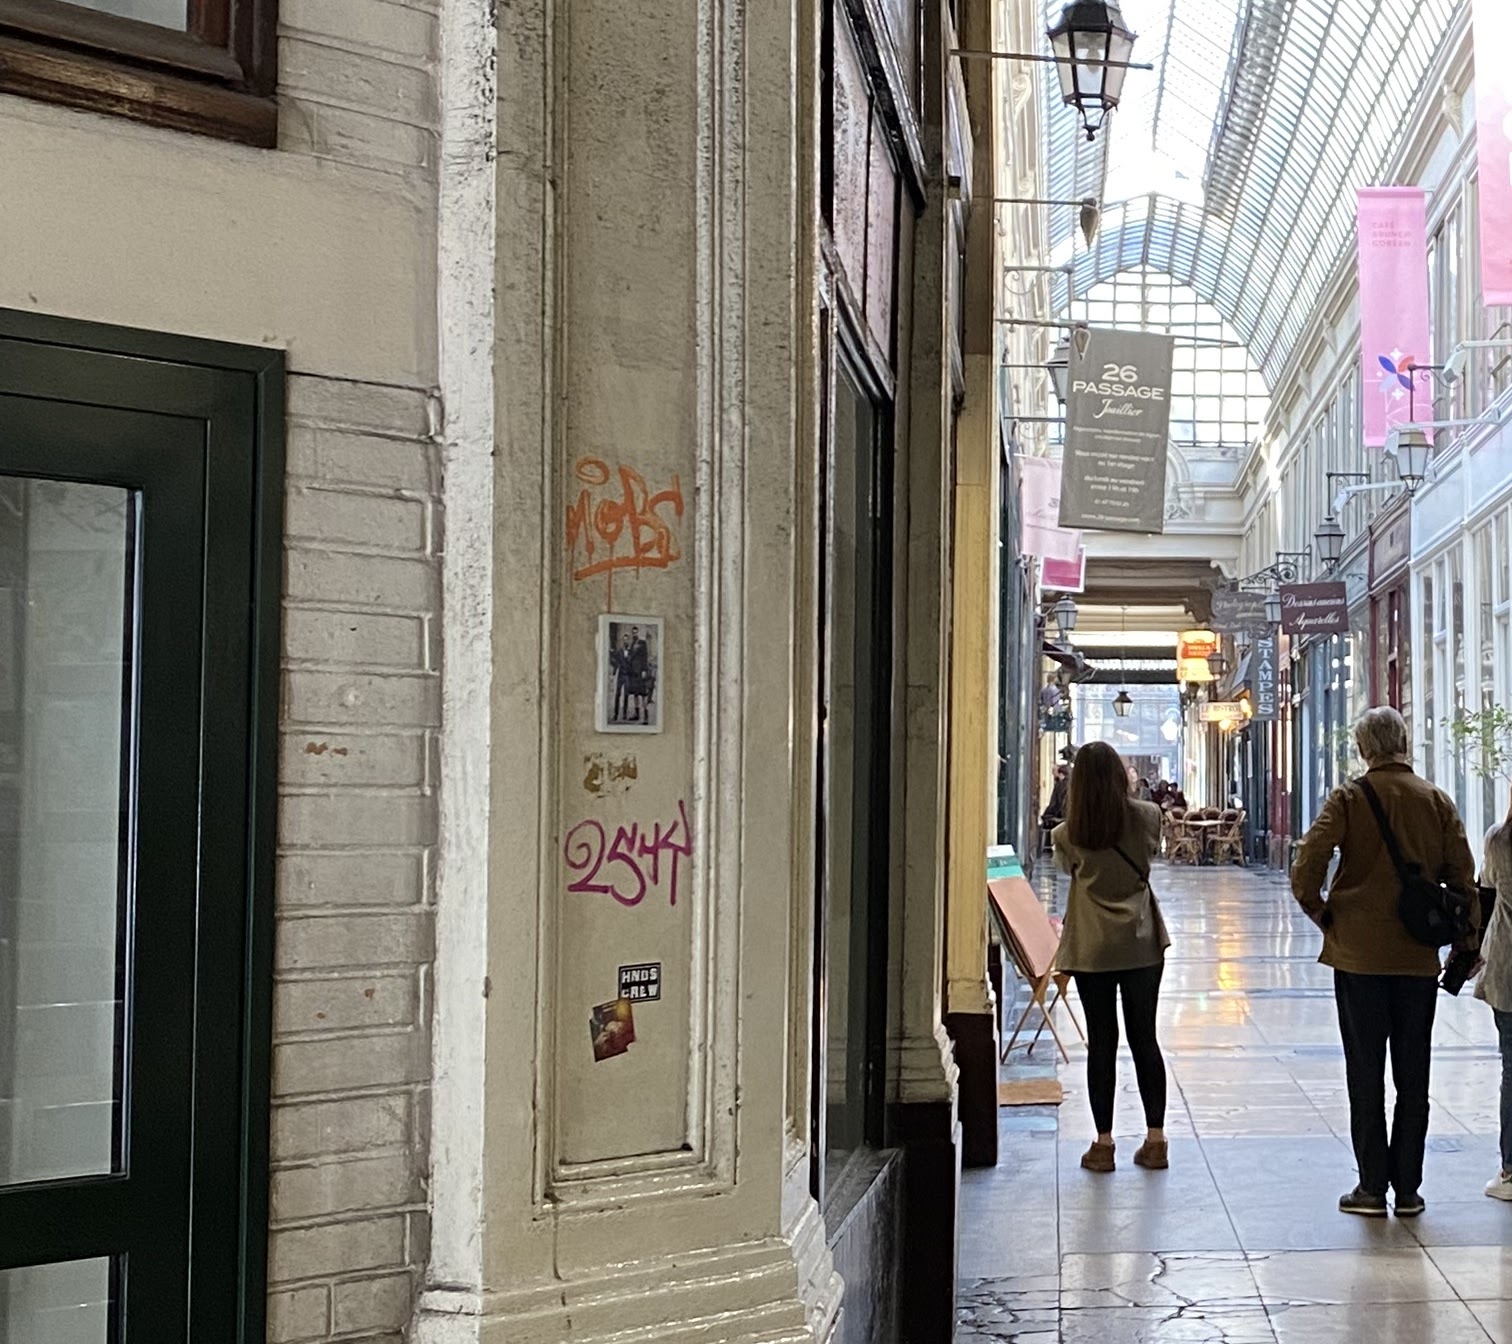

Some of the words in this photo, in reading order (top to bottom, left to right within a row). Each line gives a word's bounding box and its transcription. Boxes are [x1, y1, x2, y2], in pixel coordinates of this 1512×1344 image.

[1101, 363, 1139, 383] 26
[1072, 380, 1165, 401] PASSAGE
[1092, 398, 1144, 419] Joaillier
[1257, 630, 1275, 716] STAMPES
